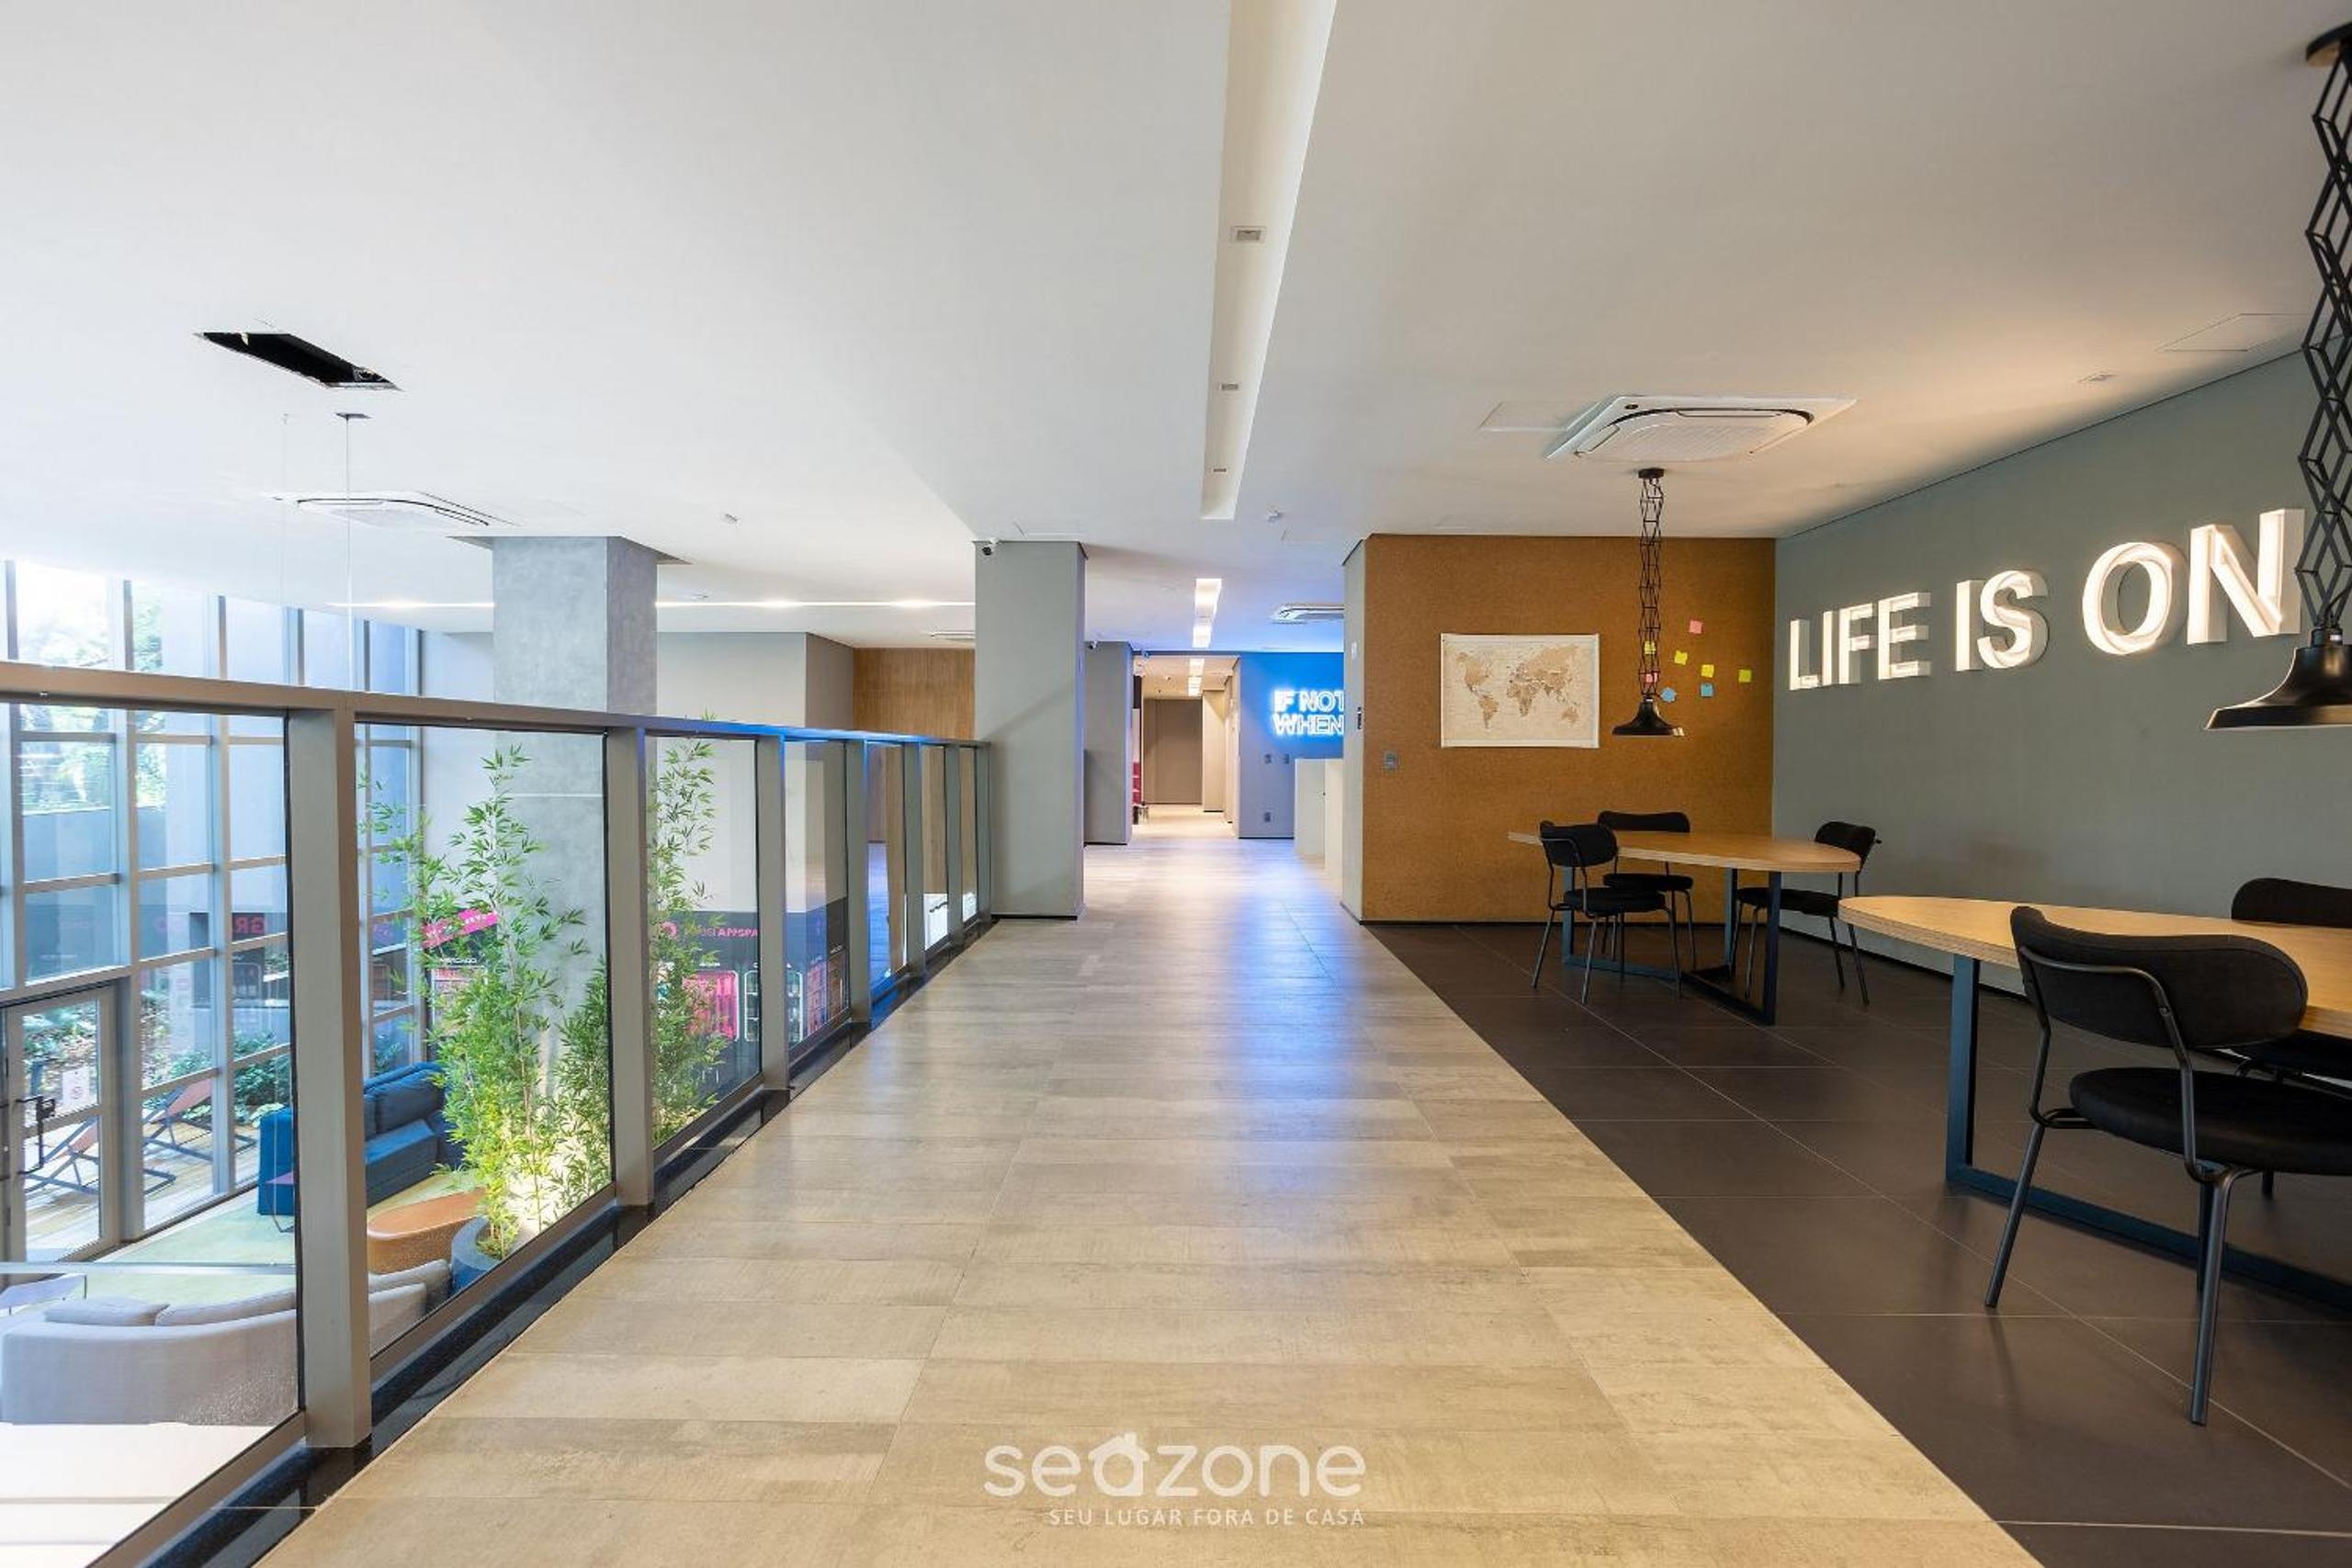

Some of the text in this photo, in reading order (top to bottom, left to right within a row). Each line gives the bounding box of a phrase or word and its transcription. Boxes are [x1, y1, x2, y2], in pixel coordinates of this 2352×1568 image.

[1789, 508, 2304, 691] LIFE IS ON
[1273, 690, 1294, 712] IF
[1272, 713, 1344, 736] WHEN
